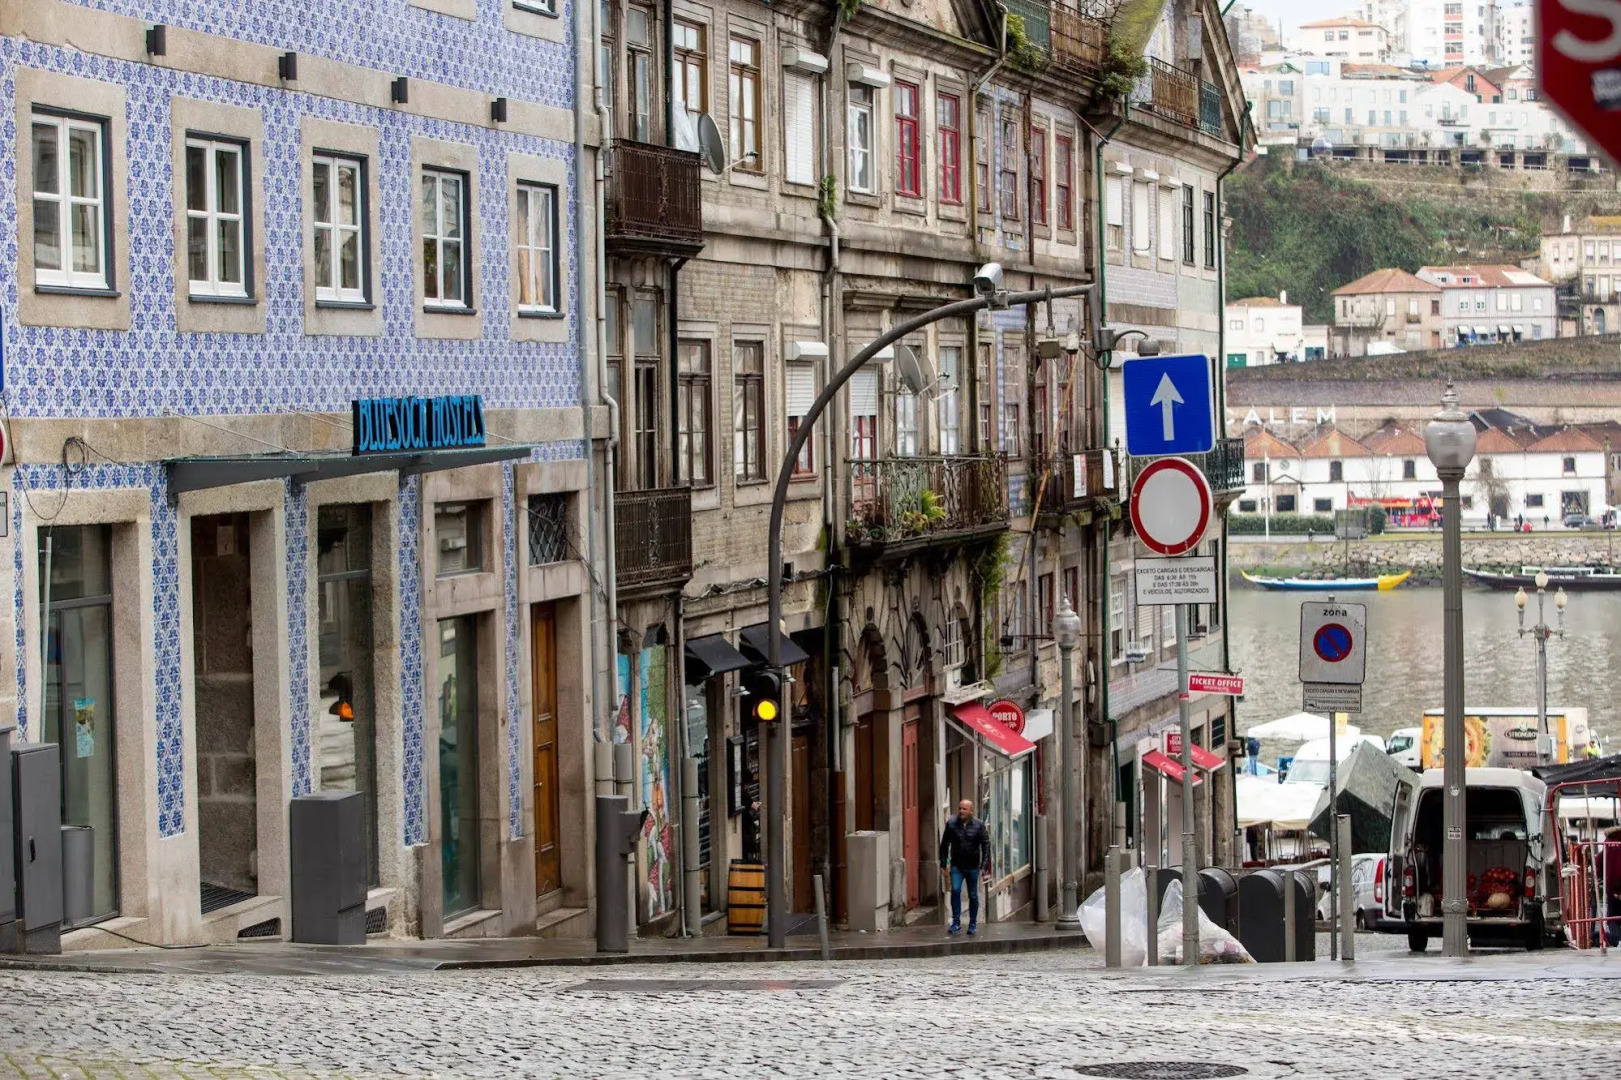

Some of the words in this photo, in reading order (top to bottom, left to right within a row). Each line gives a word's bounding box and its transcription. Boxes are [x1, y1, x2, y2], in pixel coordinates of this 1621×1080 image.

[359, 396, 428, 451] BLUESOCK
[432, 395, 485, 447] HOSTELS
[1323, 609, 1347, 617] zona
[1191, 677, 1217, 686] TICKET
[1217, 679, 1242, 688] OFFICE
[992, 711, 1018, 721] PORTO
